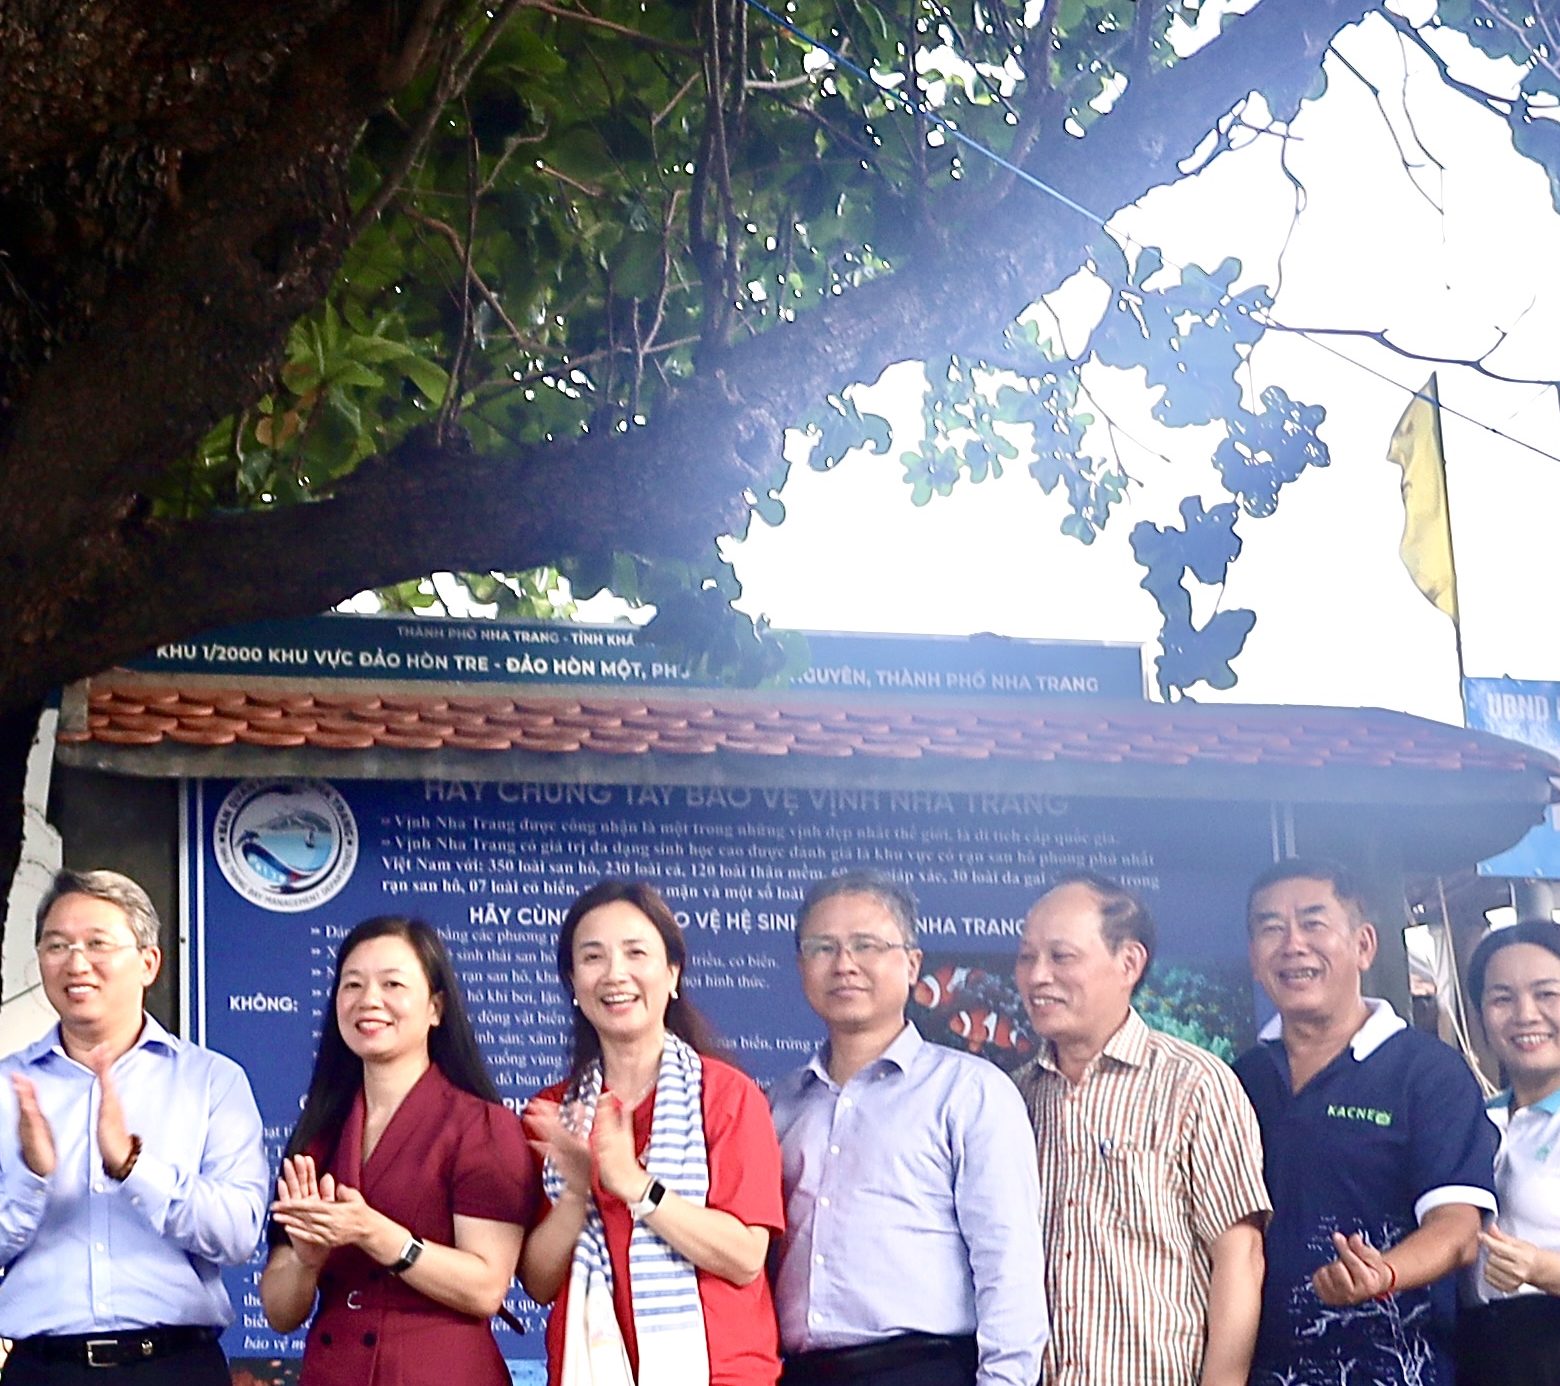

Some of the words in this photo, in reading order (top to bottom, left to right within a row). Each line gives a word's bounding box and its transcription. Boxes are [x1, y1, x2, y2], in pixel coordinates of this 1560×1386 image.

[396, 624, 444, 638] THÀNH
[481, 630, 511, 643] NHA
[514, 631, 560, 644] TRANG
[571, 629, 603, 645] TỈNH
[202, 645, 263, 662] 1/2000
[268, 648, 308, 664] KHU
[313, 646, 353, 669] VỰC
[359, 646, 401, 668] ĐẢO
[407, 651, 449, 670] HÒN
[454, 655, 489, 671] TRE
[505, 652, 549, 674] ĐẢO
[554, 655, 595, 677] HÒN
[875, 667, 941, 688] THÀNH
[946, 669, 985, 689] PHỐ
[991, 673, 1032, 691] NHA
[1036, 675, 1099, 694] TRANG
[1487, 692, 1550, 720] UBND
[890, 791, 955, 813] NHA
[967, 793, 1069, 817] TRANG
[487, 858, 514, 873] 350
[604, 860, 630, 875] 230
[691, 863, 716, 878] 120
[951, 869, 968, 883] 30
[469, 879, 488, 893] 07
[469, 902, 512, 925] HÃY
[694, 909, 721, 934] VỆ
[726, 910, 751, 934] HỆ
[915, 917, 956, 935] NHA
[229, 993, 298, 1012] KHÔNG:
[487, 989, 508, 1003] khi
